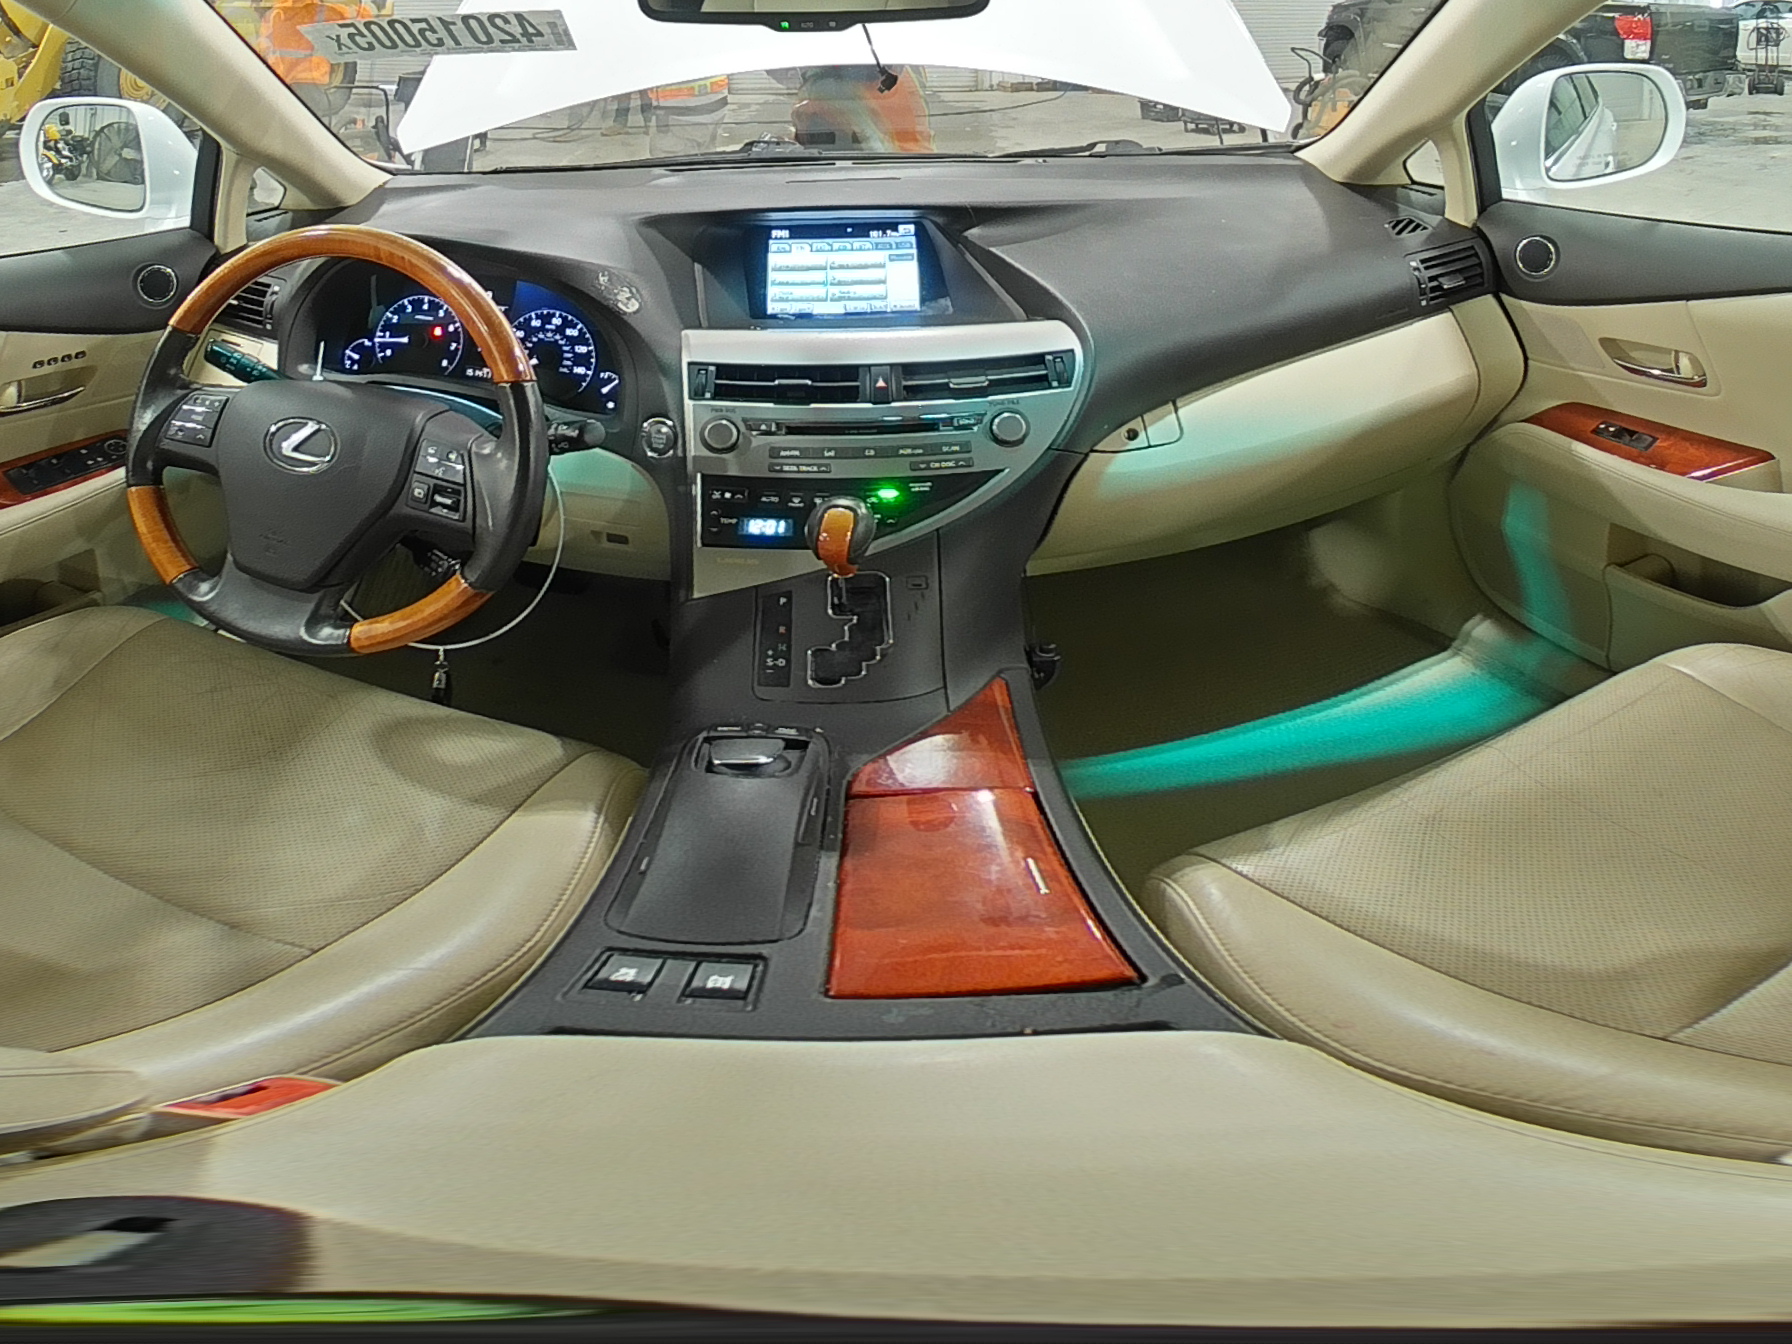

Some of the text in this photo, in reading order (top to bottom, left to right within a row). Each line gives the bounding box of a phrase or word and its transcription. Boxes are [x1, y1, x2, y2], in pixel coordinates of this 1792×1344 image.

[530, 319, 542, 327] 60
[551, 317, 563, 325] 80
[565, 328, 579, 337] 100
[574, 345, 588, 354] 120
[572, 366, 587, 375] 140
